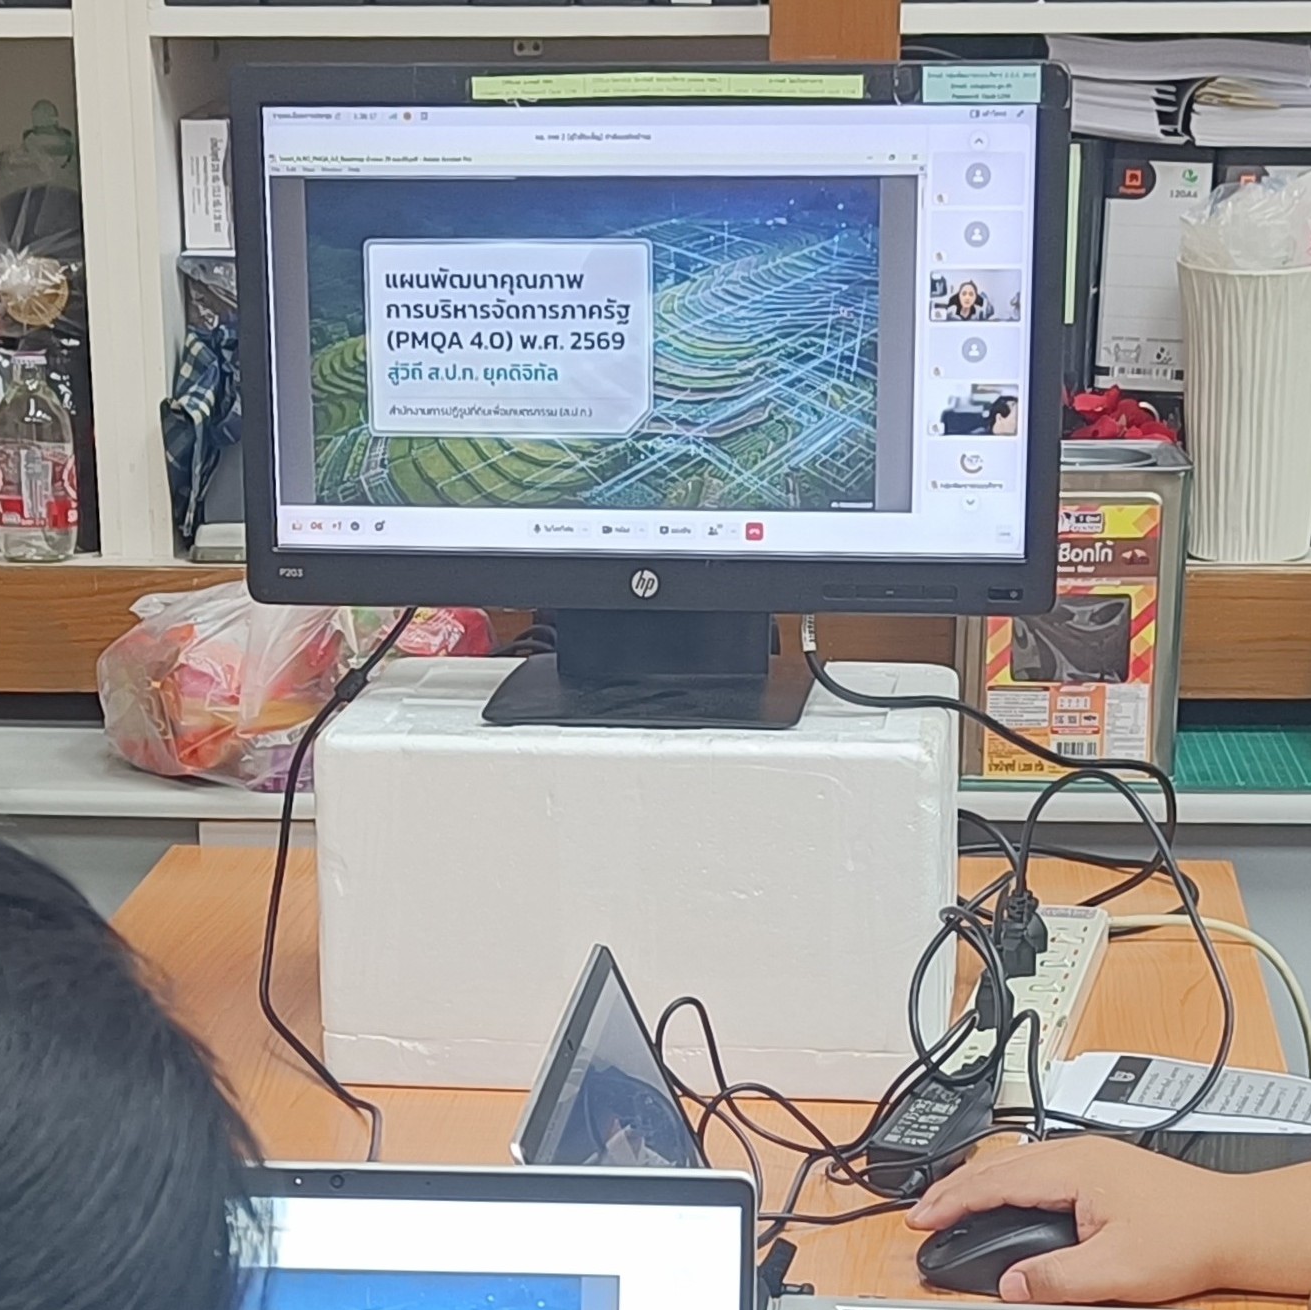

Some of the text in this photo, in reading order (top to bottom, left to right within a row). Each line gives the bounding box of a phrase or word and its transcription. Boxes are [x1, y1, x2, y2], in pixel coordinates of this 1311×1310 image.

[385, 267, 584, 295] แผนพัฒนาคุณภาพ
[386, 298, 631, 326] การบริหารจัดการภาครัฐ
[386, 330, 625, 353] (PMQA 4.0) พ.ศ. 2569
[388, 361, 559, 386] สู่วิถี ส.ป.ก. ยุคดิจิทัล
[632, 570, 659, 598] hp
